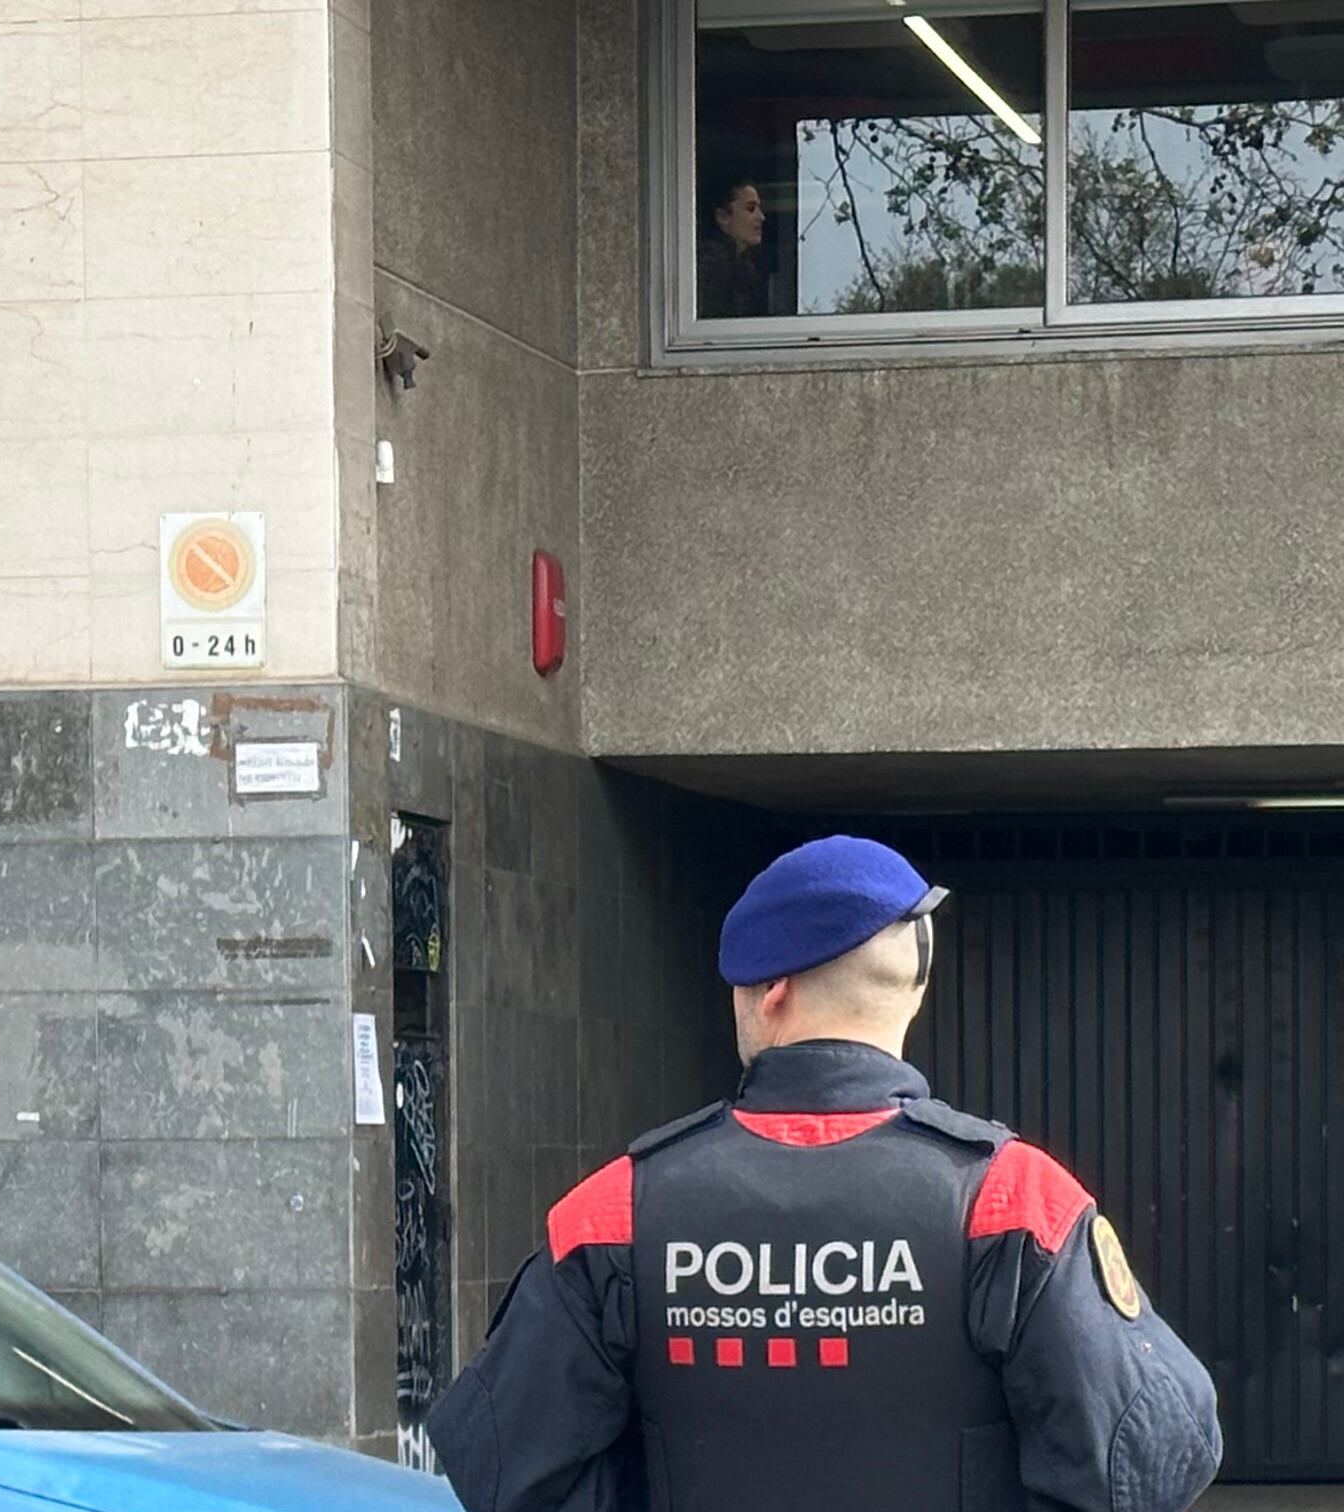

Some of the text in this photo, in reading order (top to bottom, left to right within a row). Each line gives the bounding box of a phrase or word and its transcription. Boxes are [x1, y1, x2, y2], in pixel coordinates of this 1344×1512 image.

[665, 1239, 924, 1295] POLICIA
[666, 1298, 925, 1333] mossos d'esquadra
